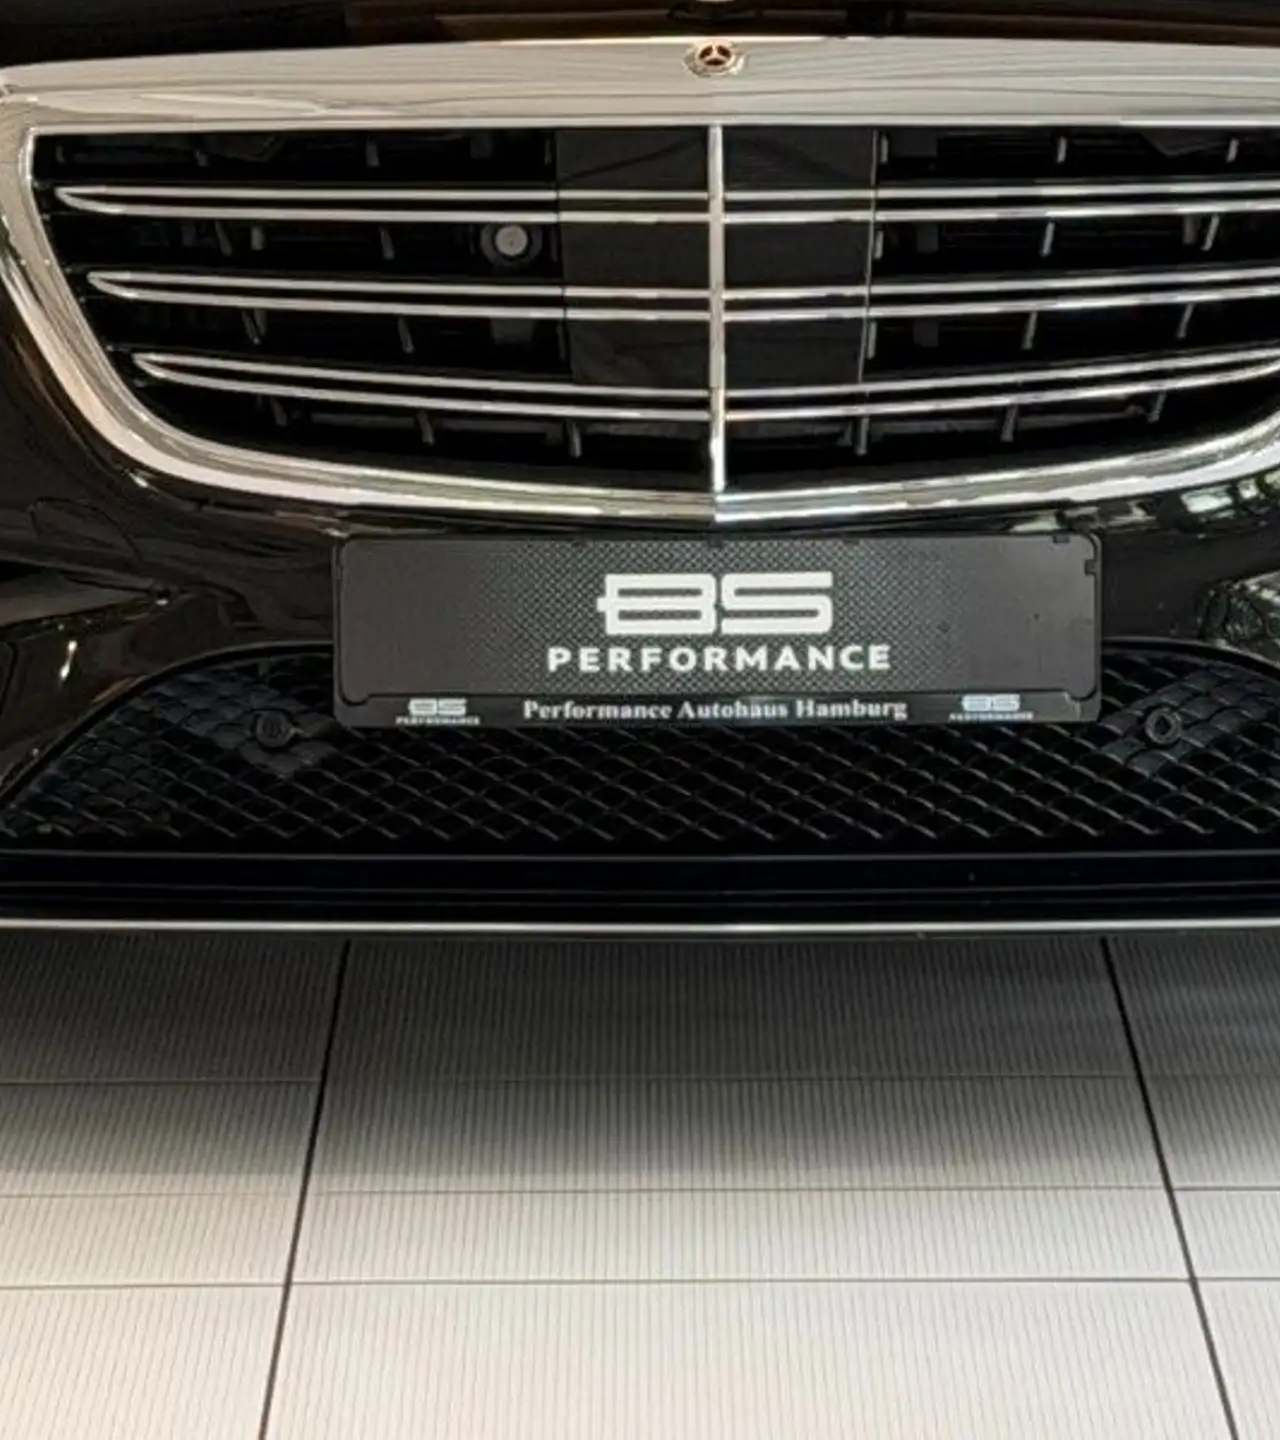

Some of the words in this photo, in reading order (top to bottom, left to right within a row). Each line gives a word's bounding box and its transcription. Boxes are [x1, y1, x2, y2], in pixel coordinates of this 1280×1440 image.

[547, 644, 892, 673] PERFORMANCE
[523, 700, 672, 720] Performance
[676, 700, 788, 719] Autohaus
[795, 699, 908, 721] Hamburg
